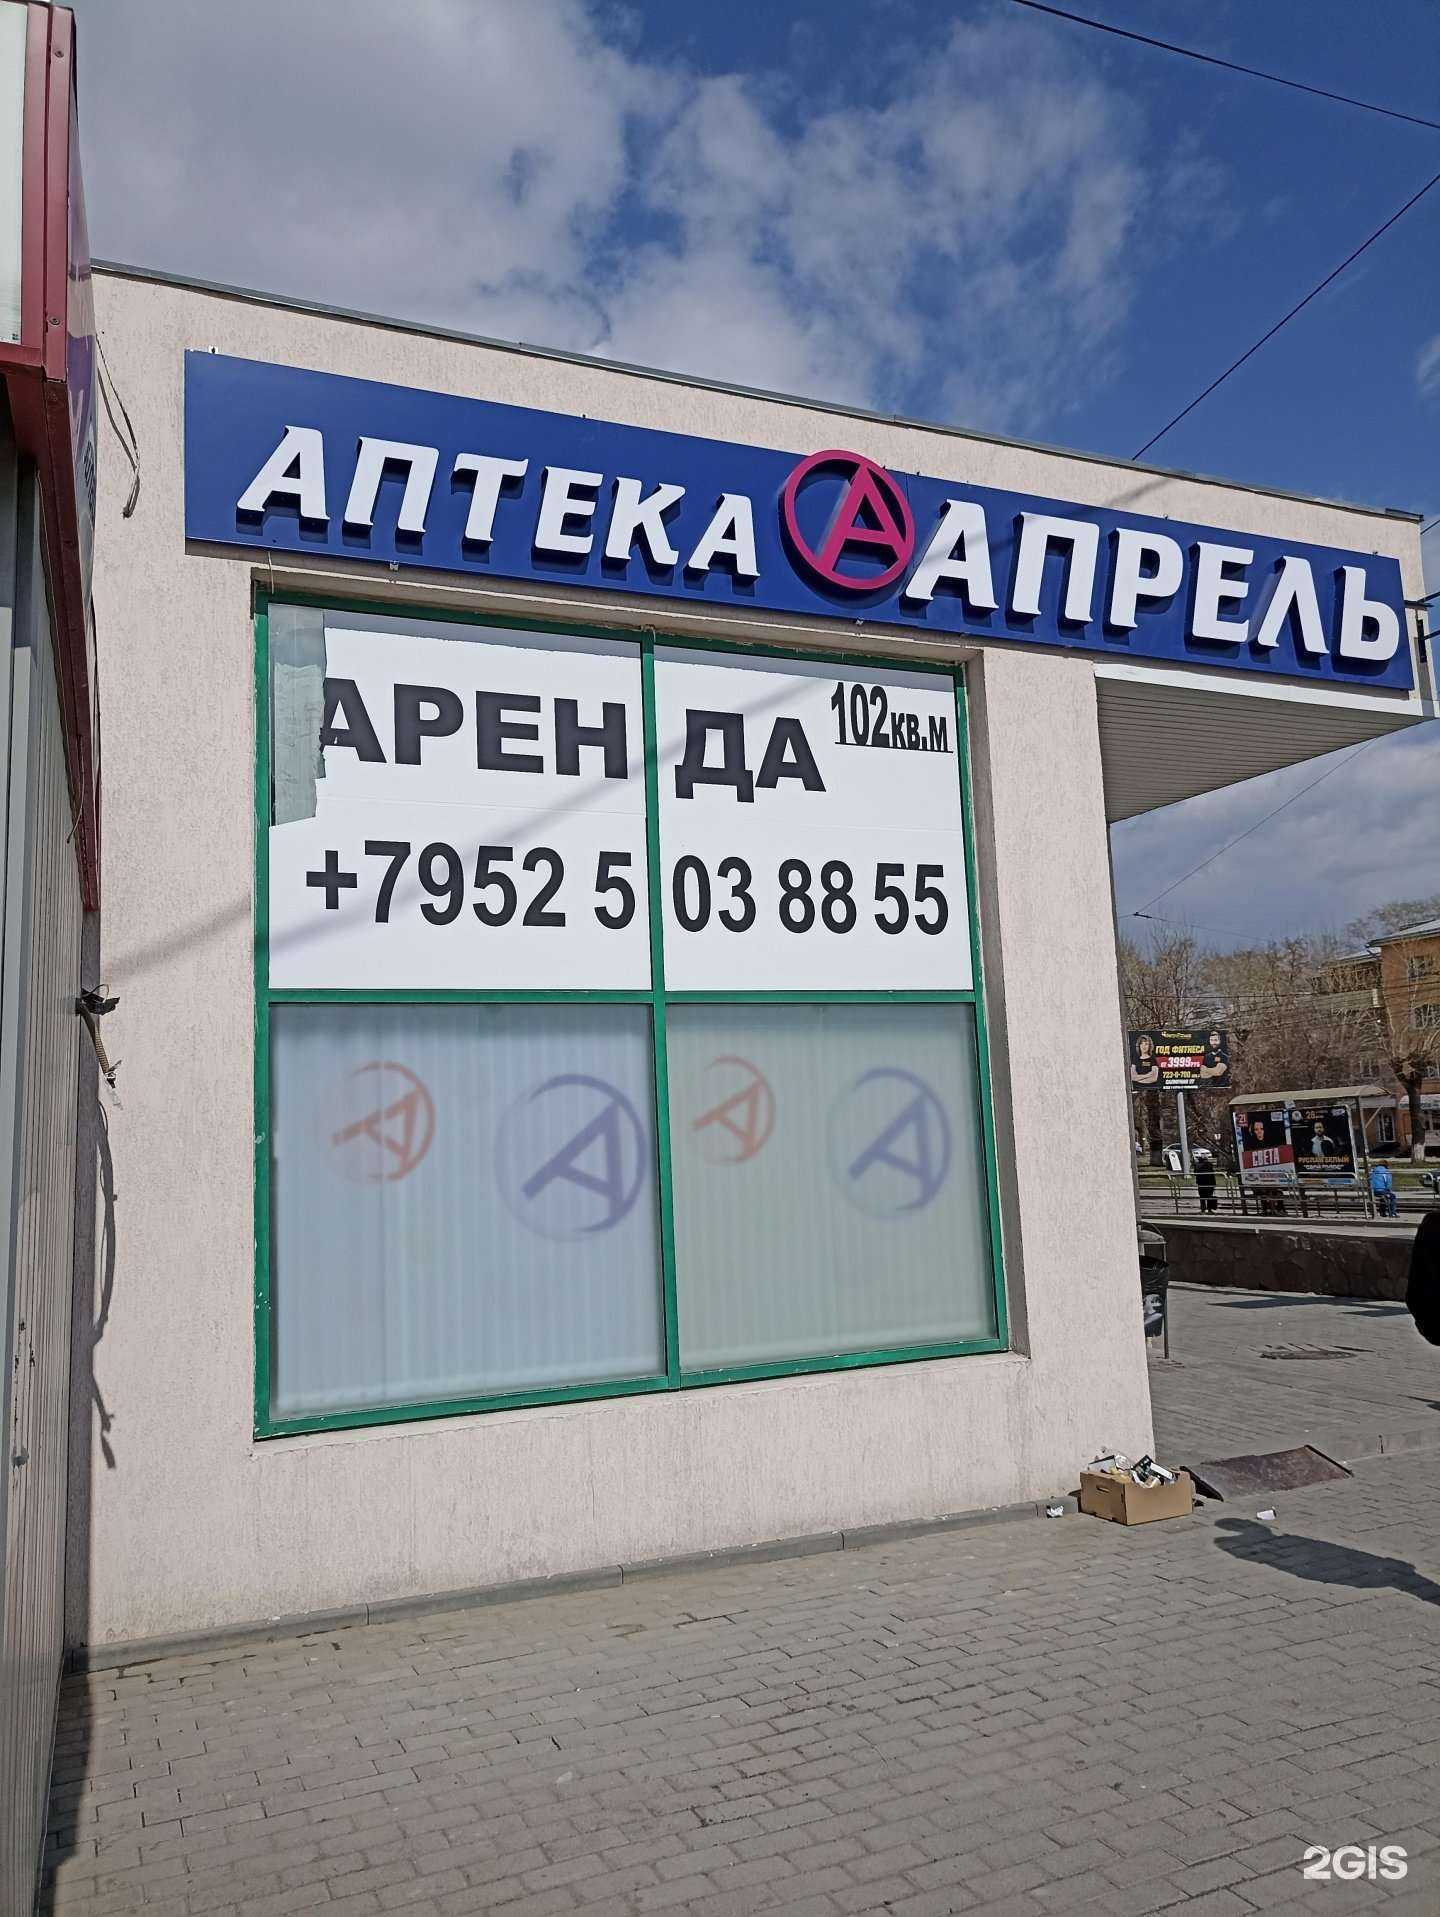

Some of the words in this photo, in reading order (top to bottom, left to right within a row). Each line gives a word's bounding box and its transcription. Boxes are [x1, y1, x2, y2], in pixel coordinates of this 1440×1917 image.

[237, 425, 761, 577] АПТЕКА
[906, 499, 1400, 661] АПРЕЛЬ
[306, 840, 566, 927] +7952
[778, 859, 857, 934] 88
[874, 863, 949, 935] 55
[1155, 1045, 1170, 1055] ГОД
[1171, 1045, 1205, 1054] ФИТНЕСА
